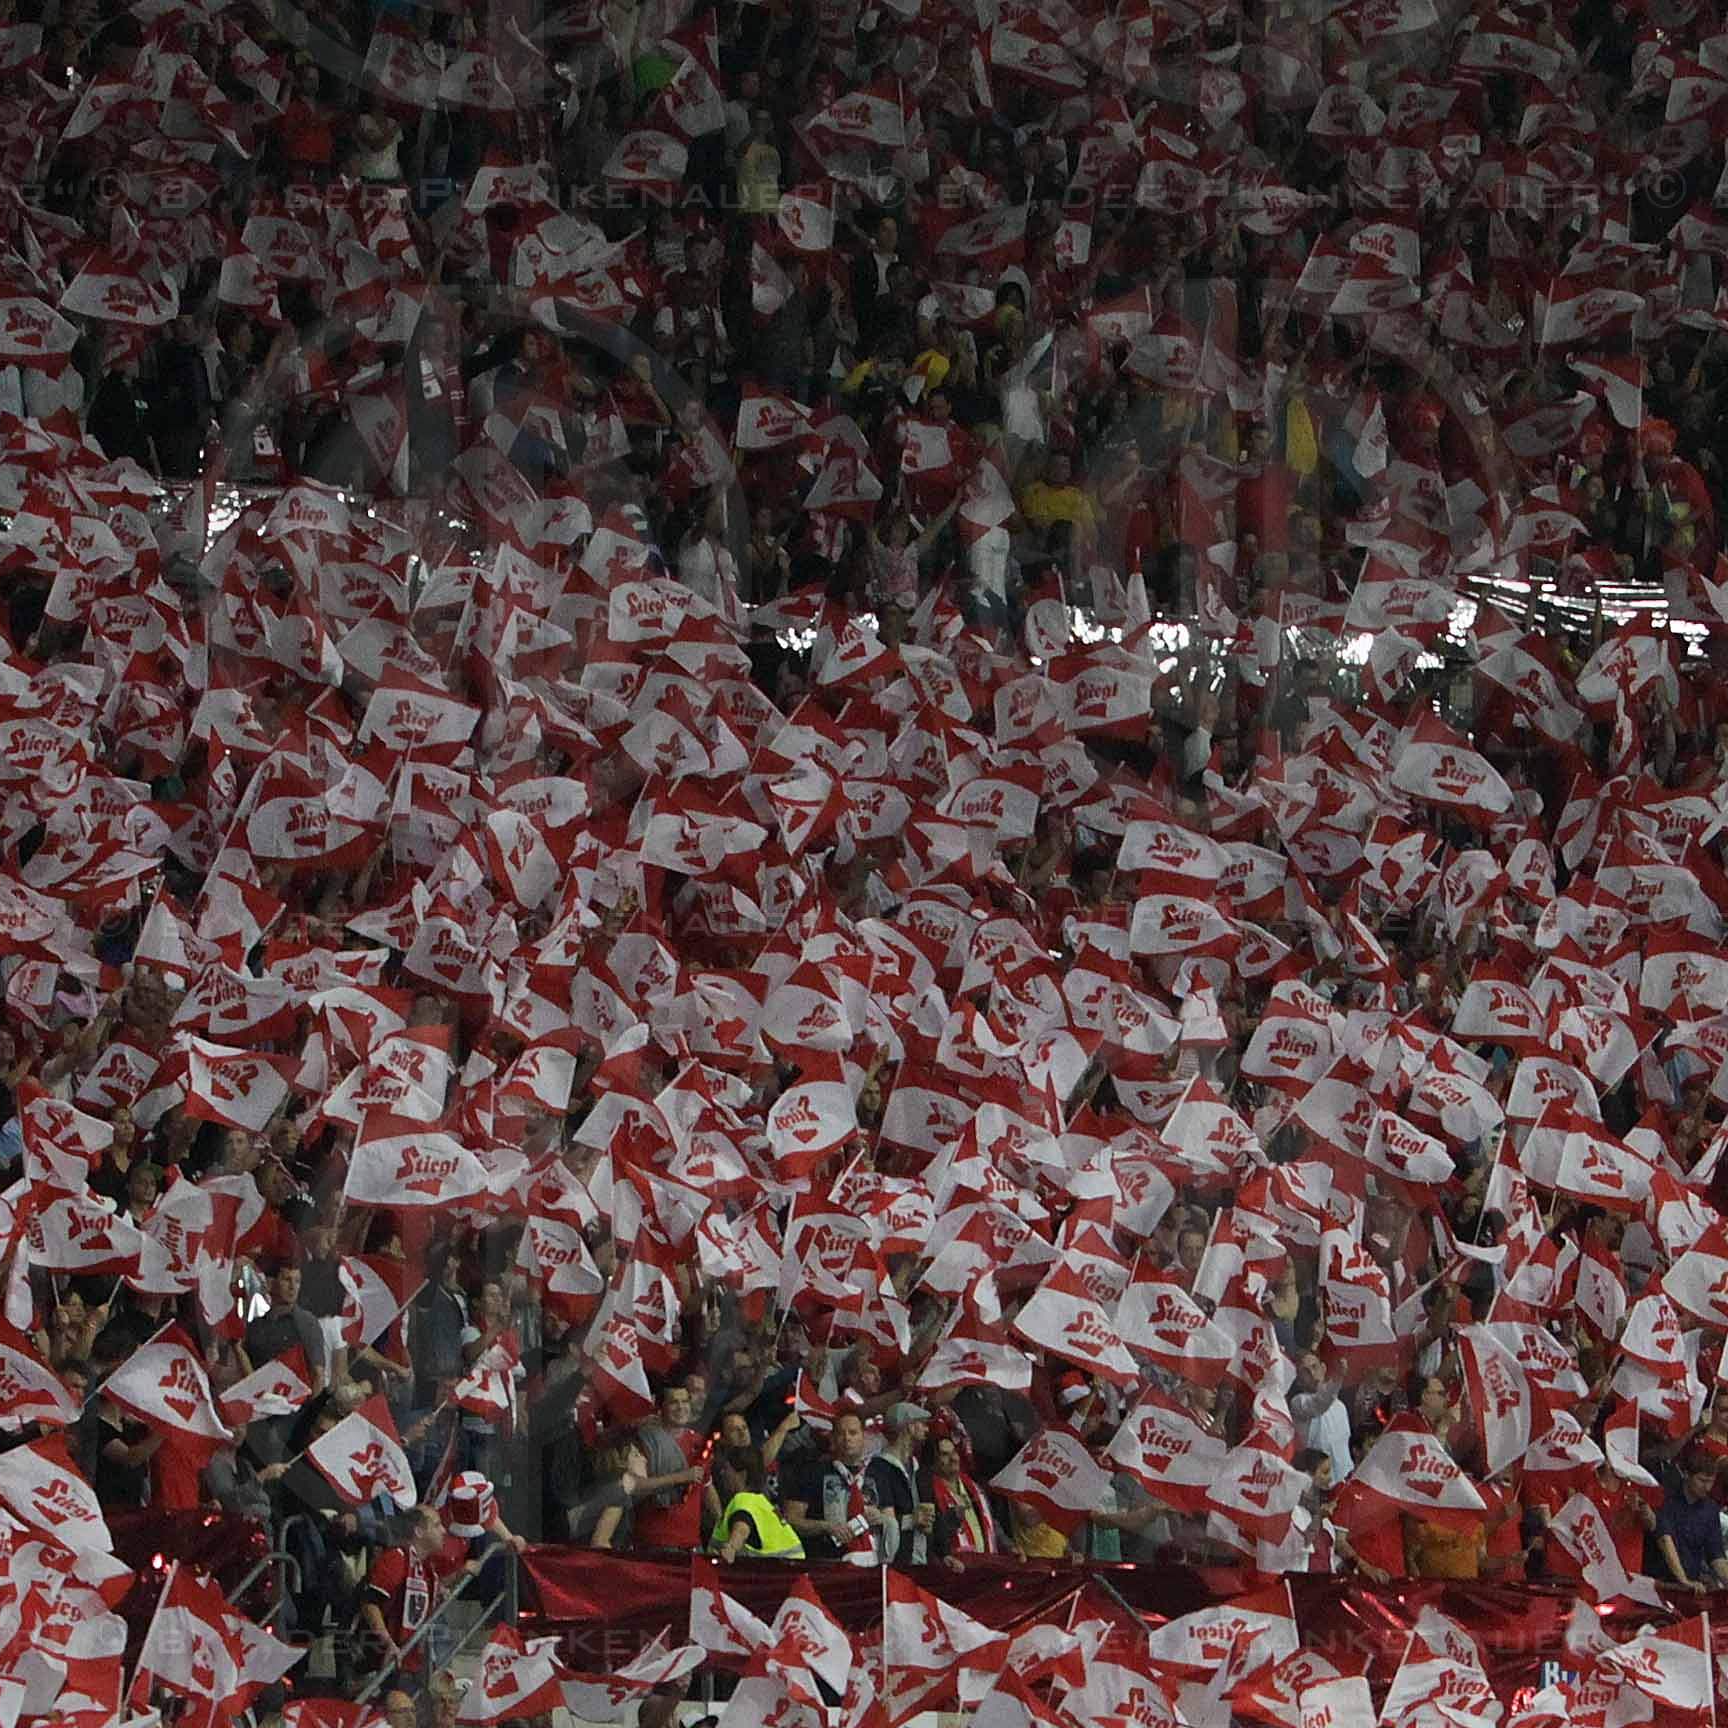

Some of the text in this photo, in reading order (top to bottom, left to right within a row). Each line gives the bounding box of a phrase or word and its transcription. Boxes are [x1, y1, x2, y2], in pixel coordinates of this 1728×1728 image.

[1268, 1027, 1320, 1061] Stiegl
[1378, 1114, 1431, 1158] Stiegl
[394, 1146, 462, 1181] Stiegl
[1149, 1292, 1212, 1331] Stiegl
[347, 1443, 407, 1495] Stiegl
[32, 1478, 98, 1523] Stiegl
